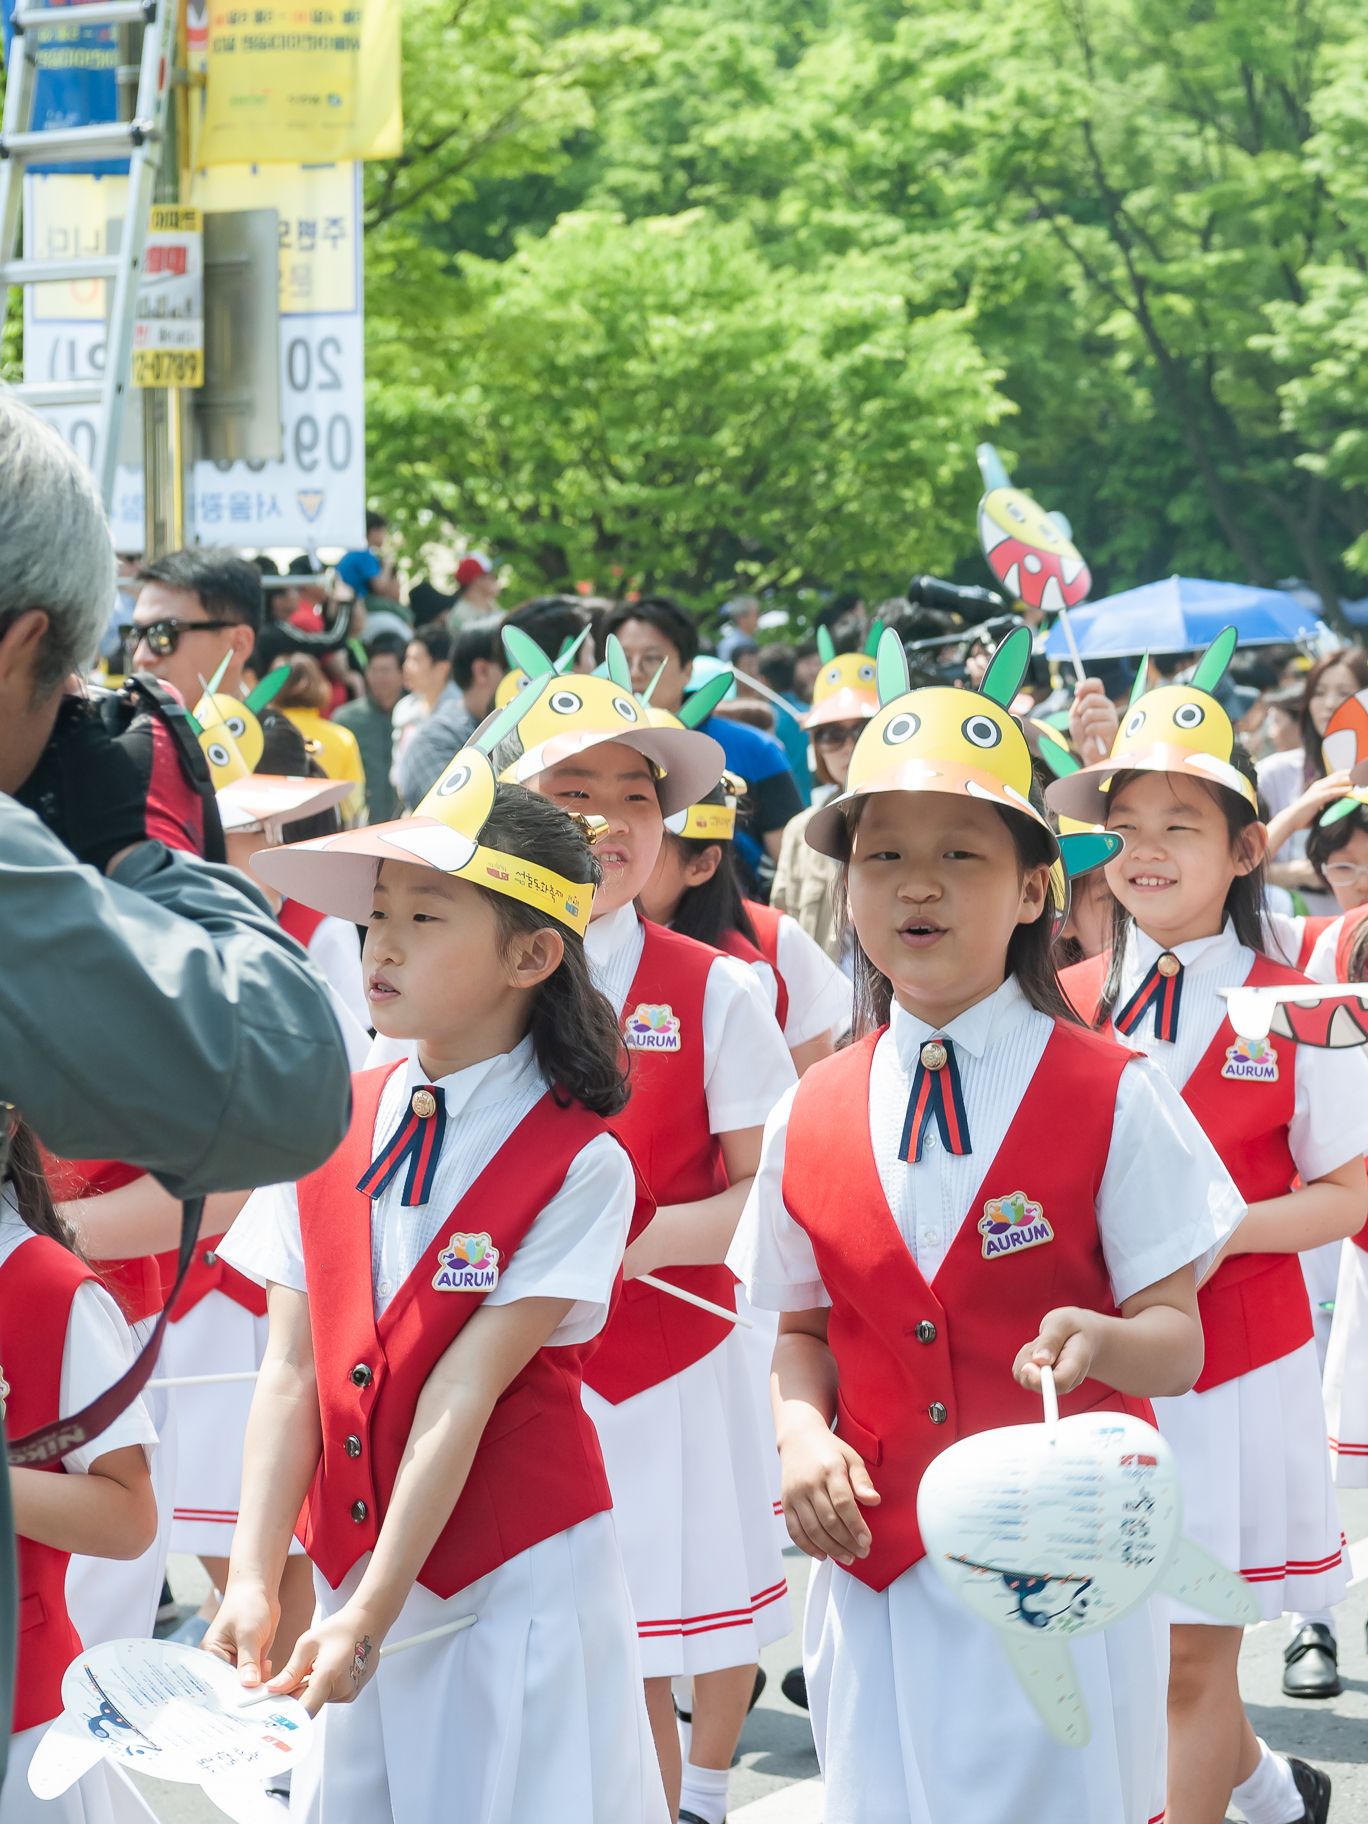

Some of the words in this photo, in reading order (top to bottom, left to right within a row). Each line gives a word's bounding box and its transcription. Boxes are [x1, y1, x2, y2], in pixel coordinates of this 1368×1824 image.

[625, 1034, 677, 1048] AURUM
[1225, 1064, 1275, 1079] AURUM
[986, 1223, 1050, 1256] AURUM
[437, 1271, 495, 1287] AURUM
